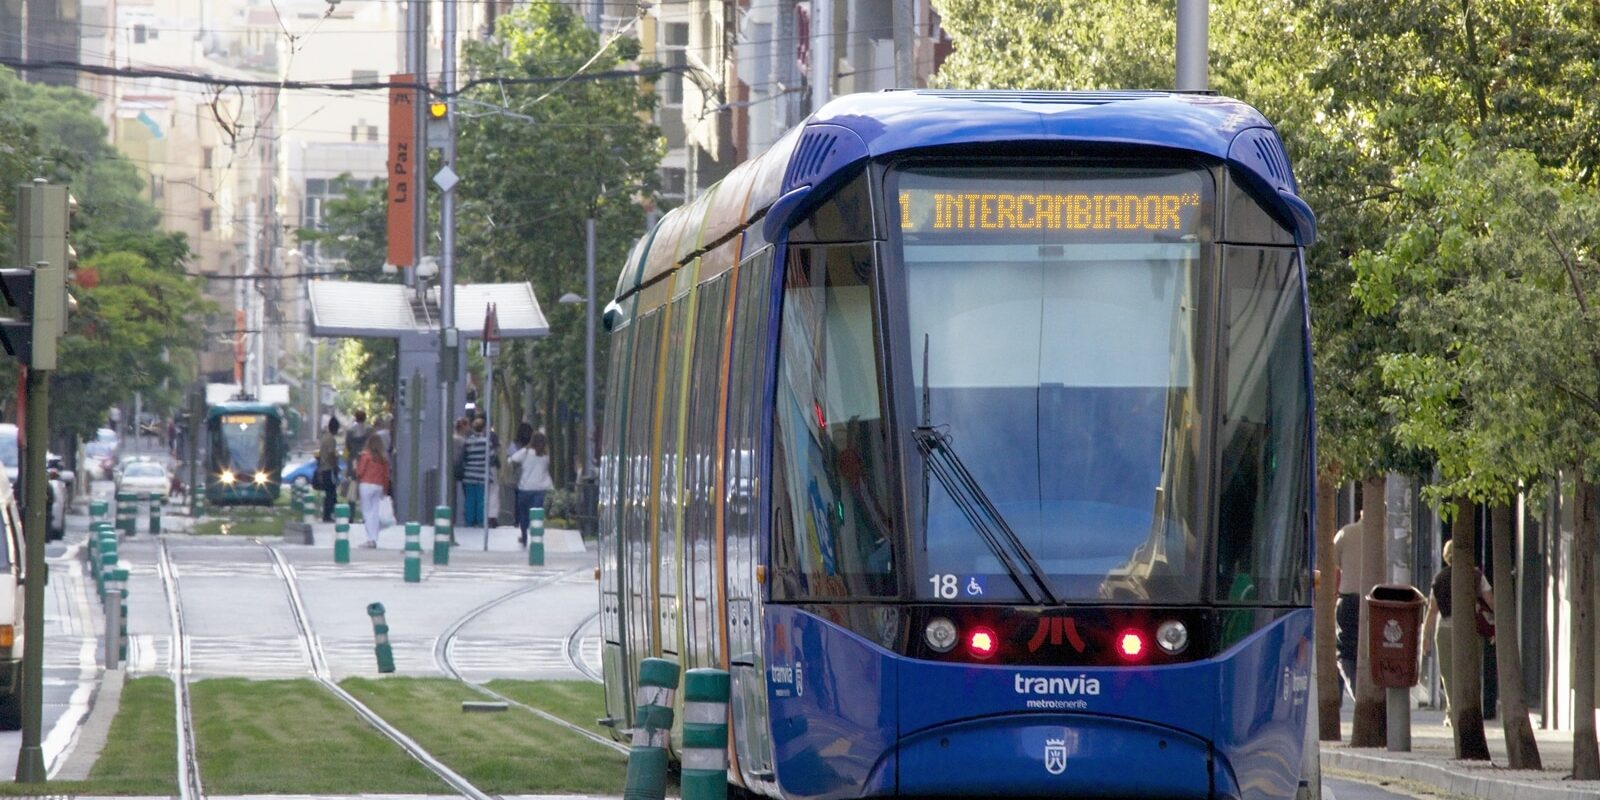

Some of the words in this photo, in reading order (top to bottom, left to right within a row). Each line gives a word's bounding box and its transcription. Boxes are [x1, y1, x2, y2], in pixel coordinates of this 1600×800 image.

[394, 142, 407, 175] Paz
[394, 182, 407, 203] La
[899, 193, 914, 228] 1
[933, 193, 1181, 229] INTERCAMBIADOR
[929, 574, 958, 599] 18
[1026, 699, 1088, 709] metrotenerife
